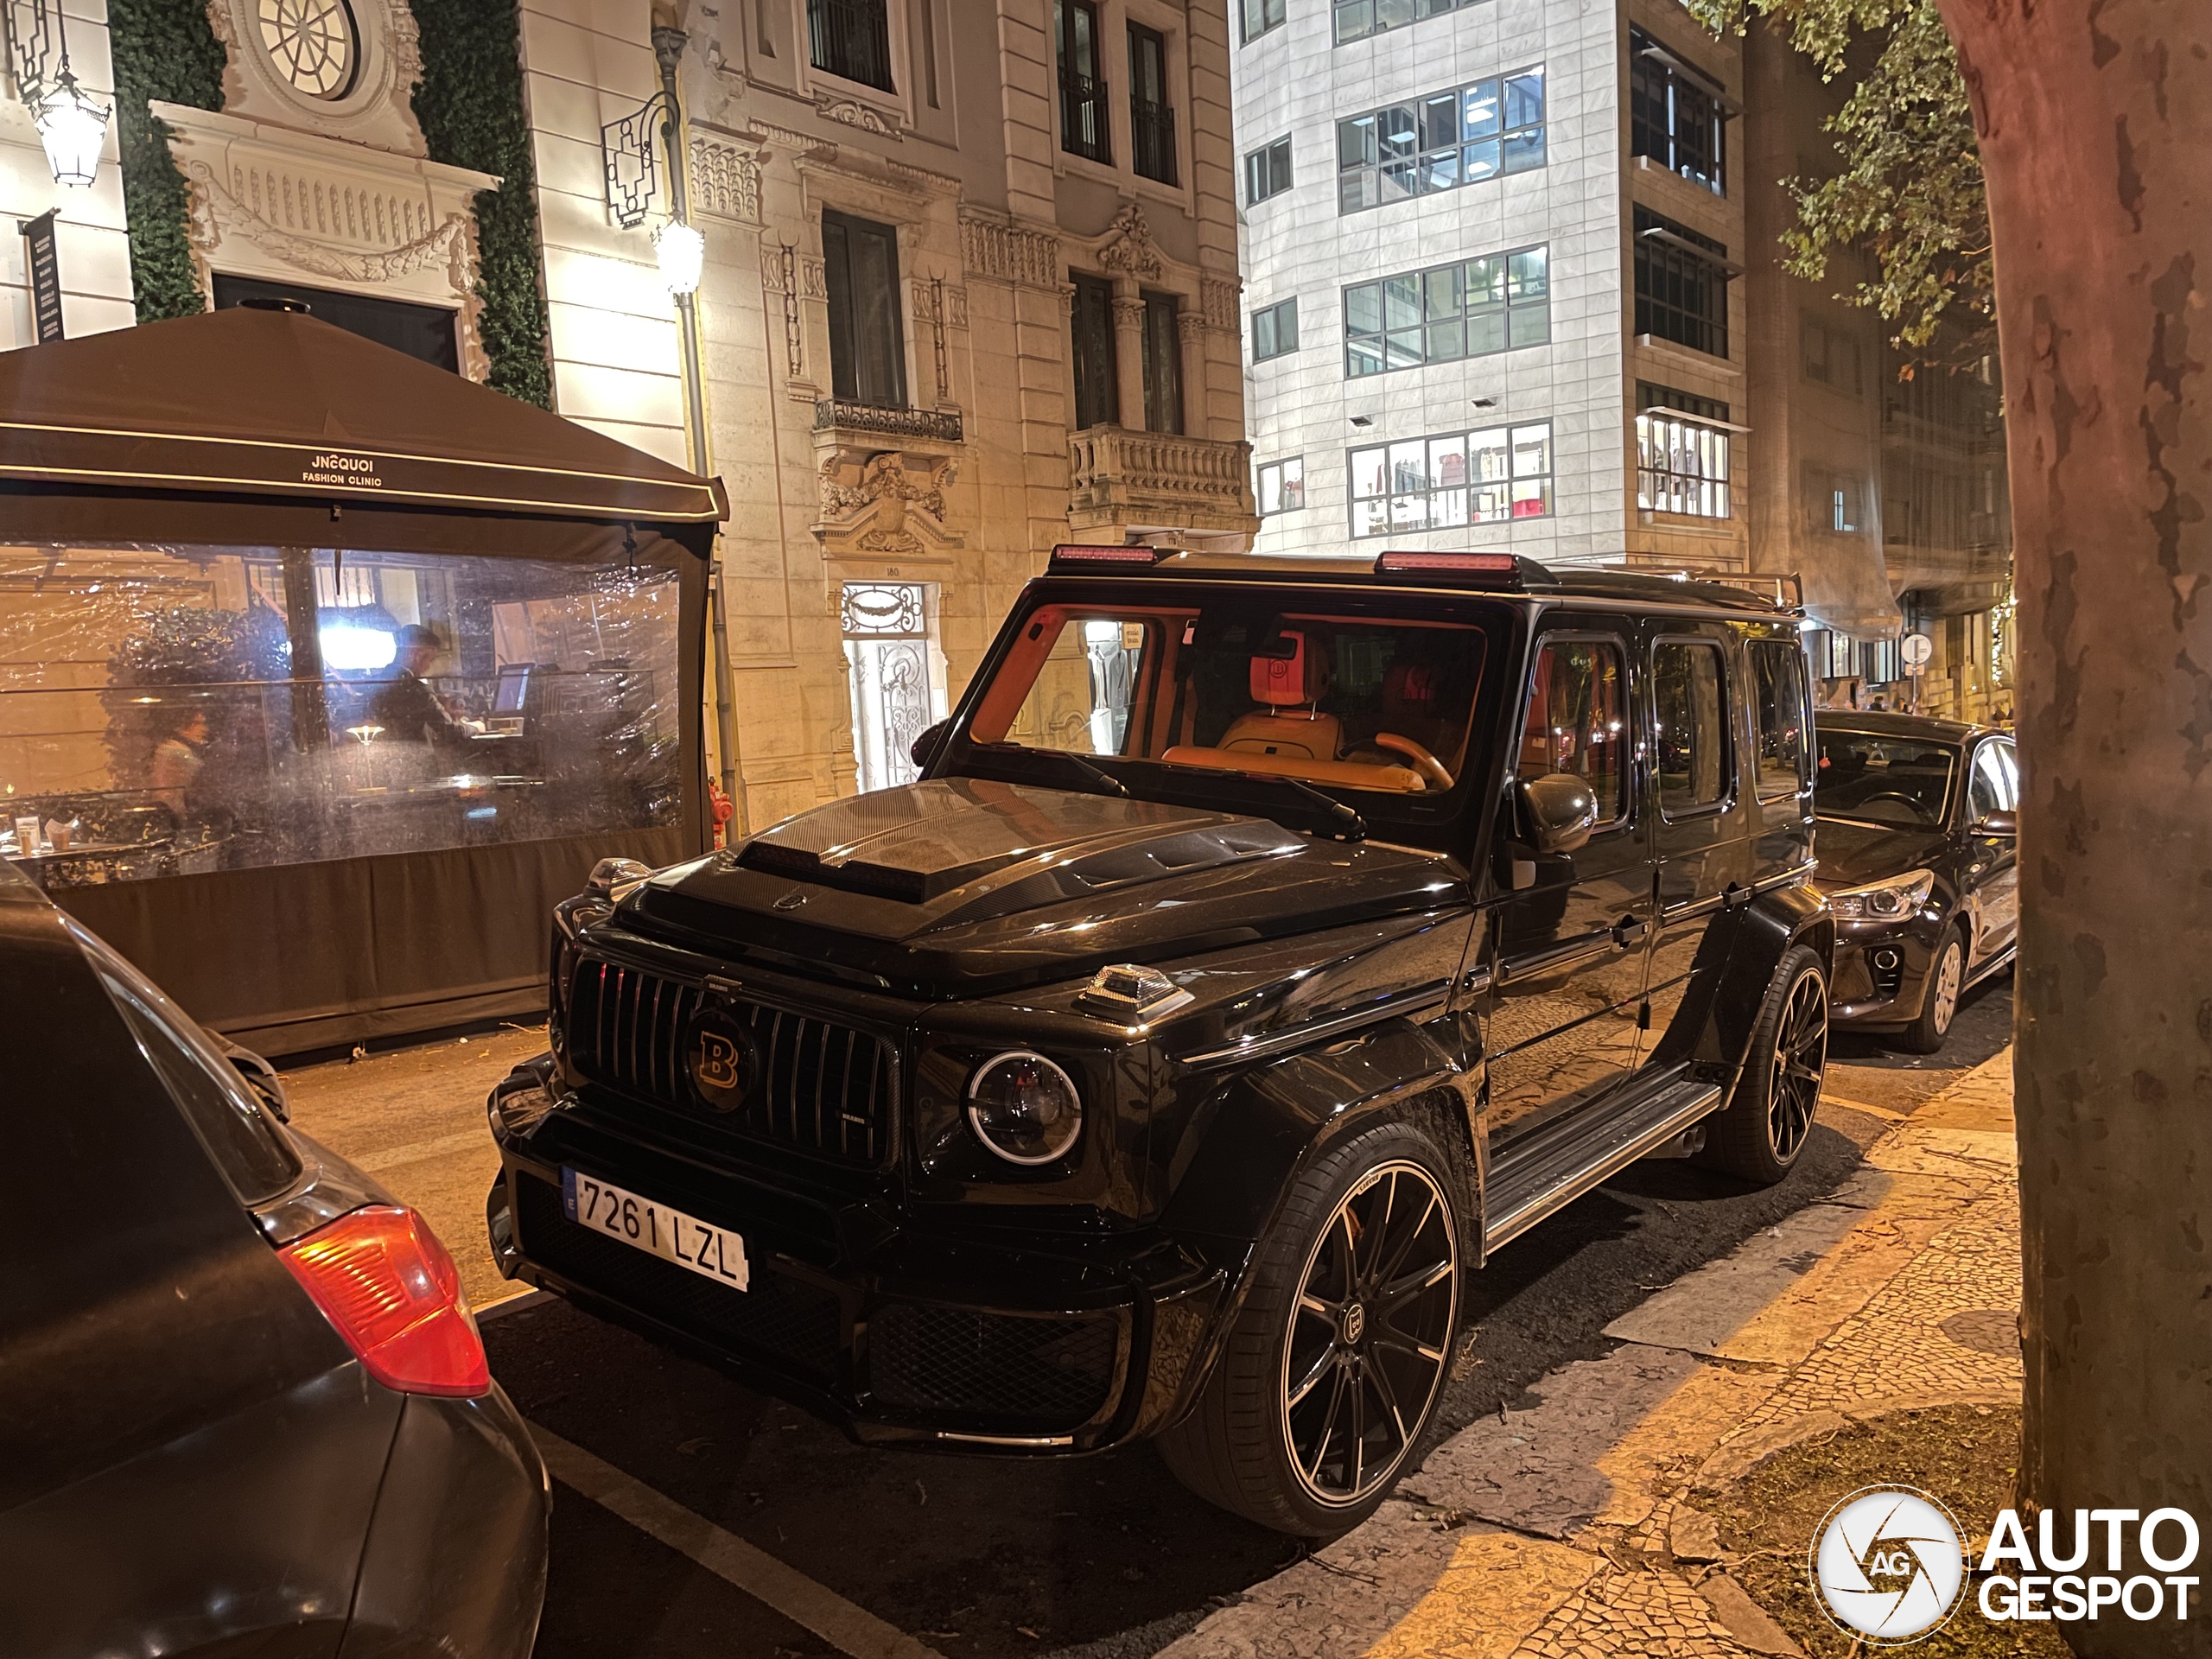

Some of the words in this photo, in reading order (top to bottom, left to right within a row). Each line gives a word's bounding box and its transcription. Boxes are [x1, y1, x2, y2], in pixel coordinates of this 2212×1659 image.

[302, 472, 344, 484] FASHION
[348, 475, 382, 486] CLINIC
[887, 567, 899, 577] 180
[699, 1030, 739, 1089] B
[584, 1180, 657, 1248] 7261
[674, 1217, 737, 1281] LZL
